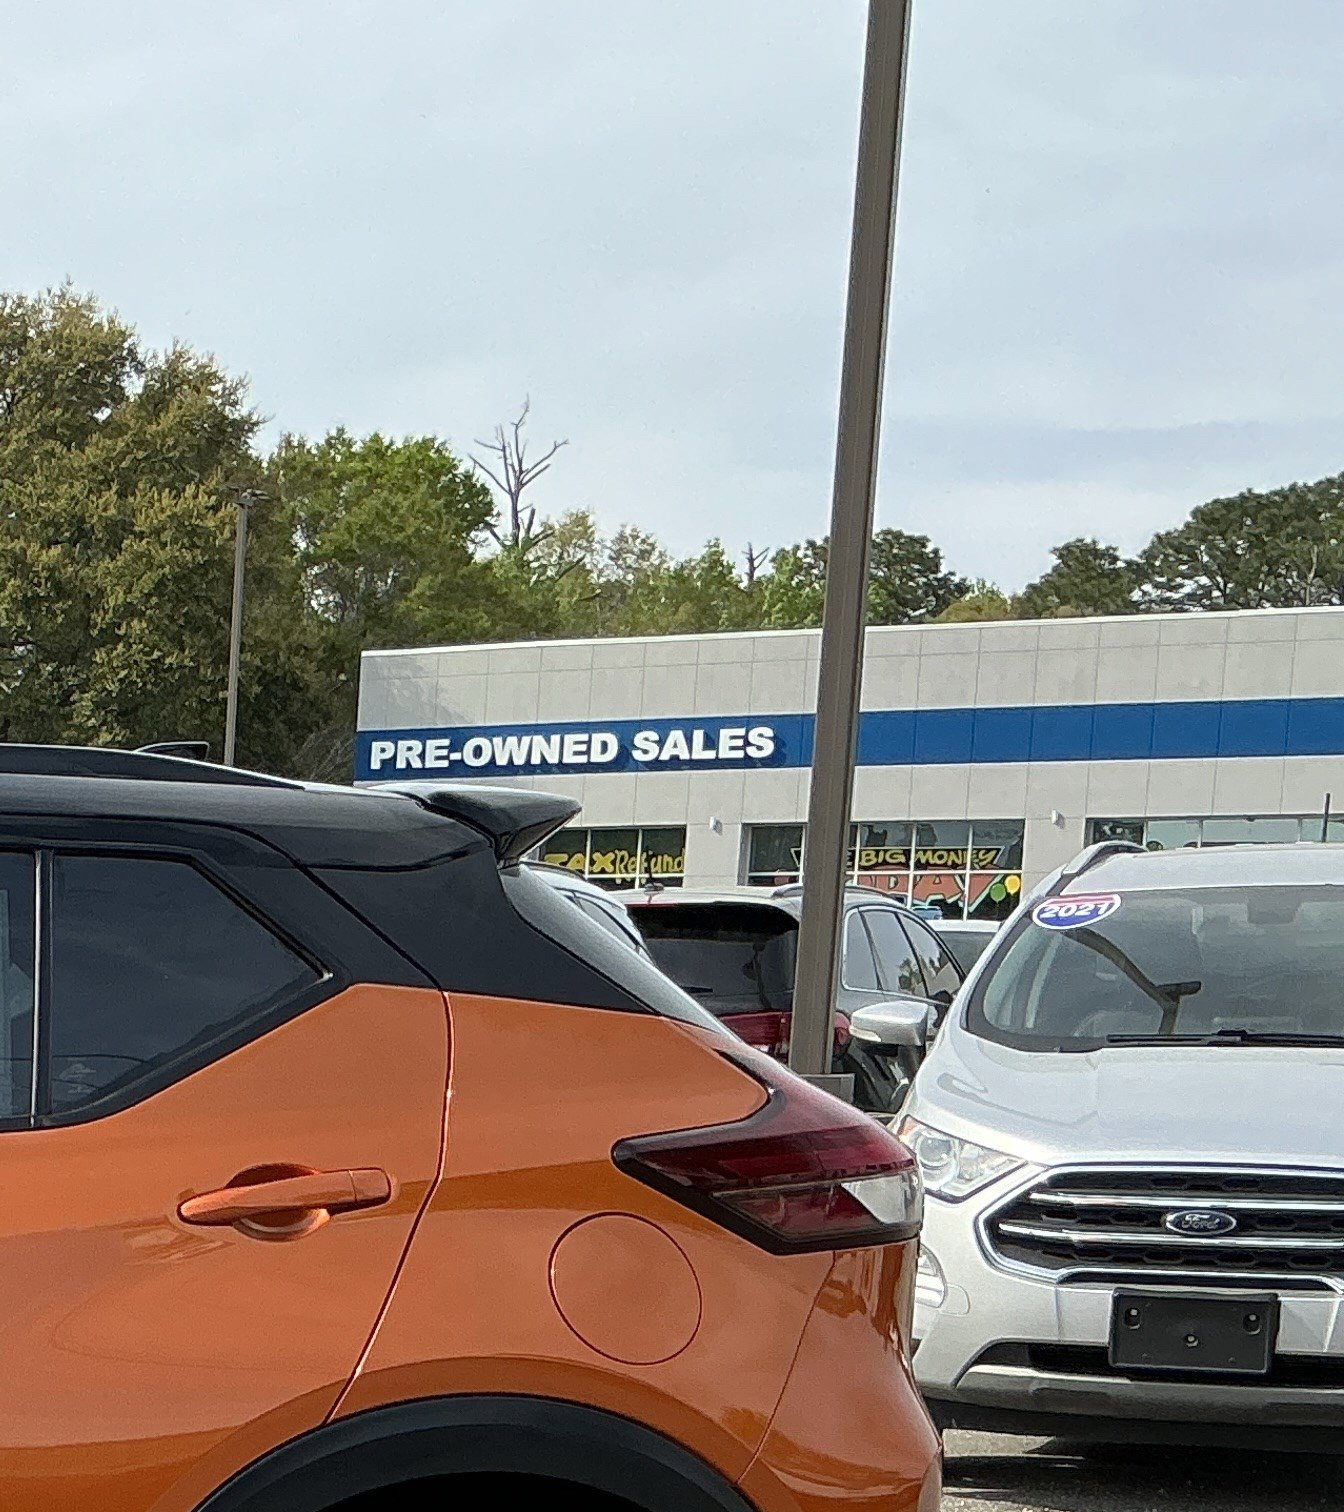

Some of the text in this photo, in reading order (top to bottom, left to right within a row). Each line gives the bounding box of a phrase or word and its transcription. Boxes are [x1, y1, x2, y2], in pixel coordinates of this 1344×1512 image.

[370, 726, 776, 770] PRE-OWNED SALES
[543, 851, 615, 873] TAX
[859, 849, 906, 866] BIG
[913, 849, 997, 867] MONEY
[1039, 902, 1110, 919] 2021
[1181, 1213, 1221, 1229] Ford
